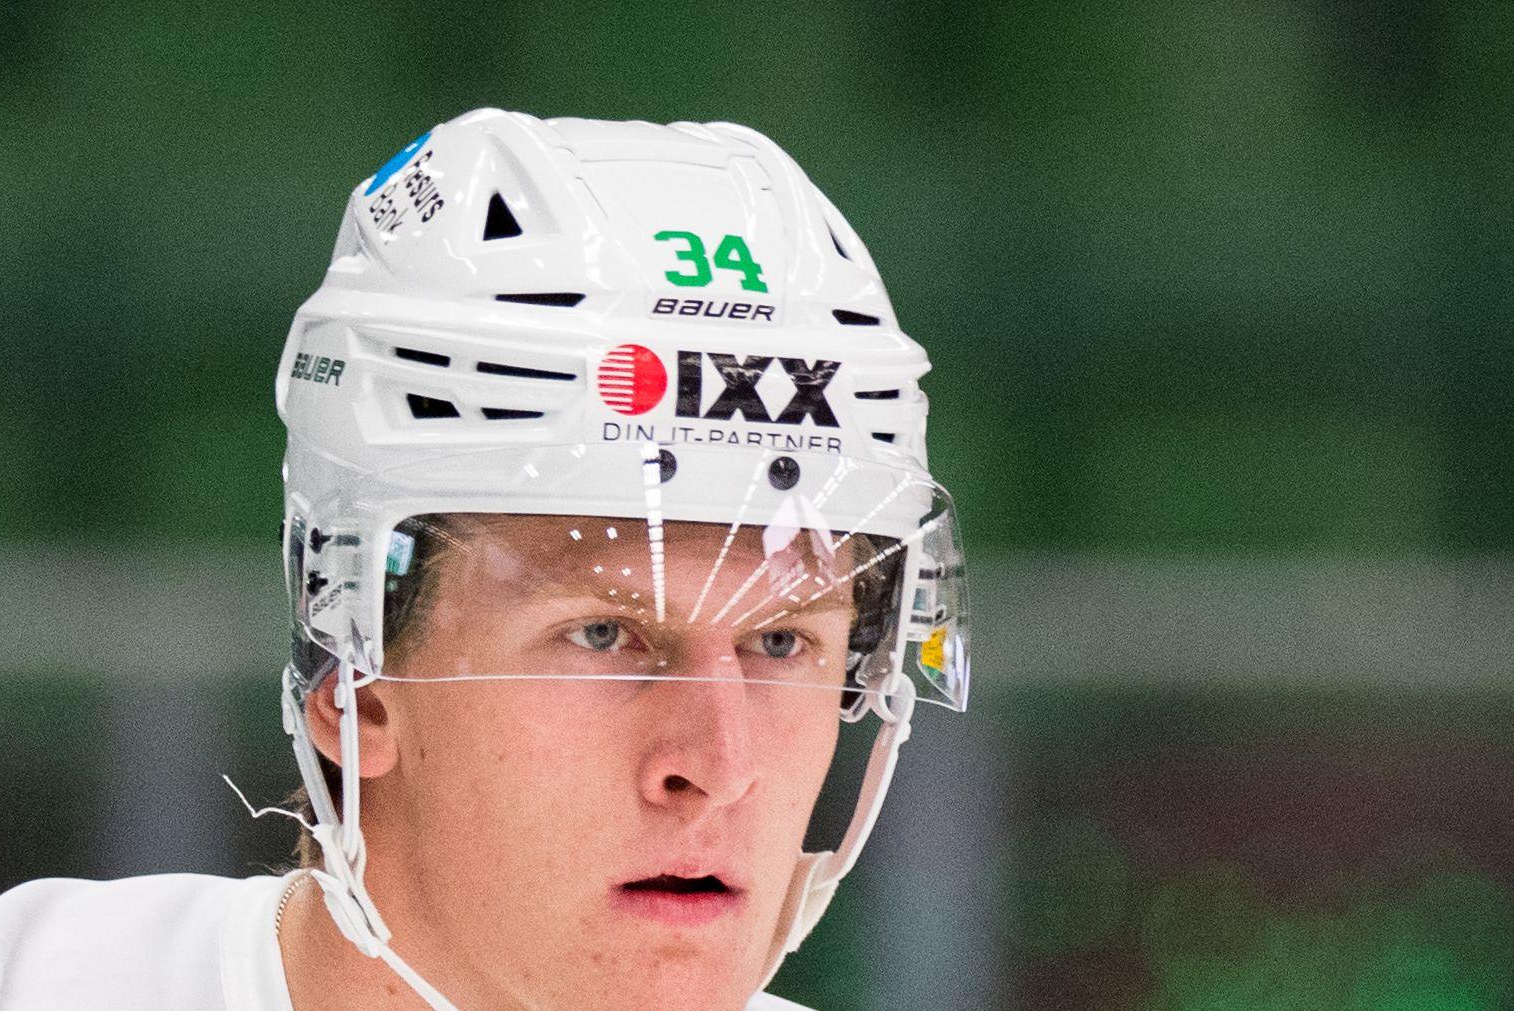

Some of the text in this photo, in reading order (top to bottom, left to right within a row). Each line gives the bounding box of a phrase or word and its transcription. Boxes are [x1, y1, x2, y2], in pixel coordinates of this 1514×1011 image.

[652, 230, 769, 294] 34
[652, 298, 776, 322] BAUER
[675, 350, 842, 428] IXX
[602, 422, 655, 442] DIN
